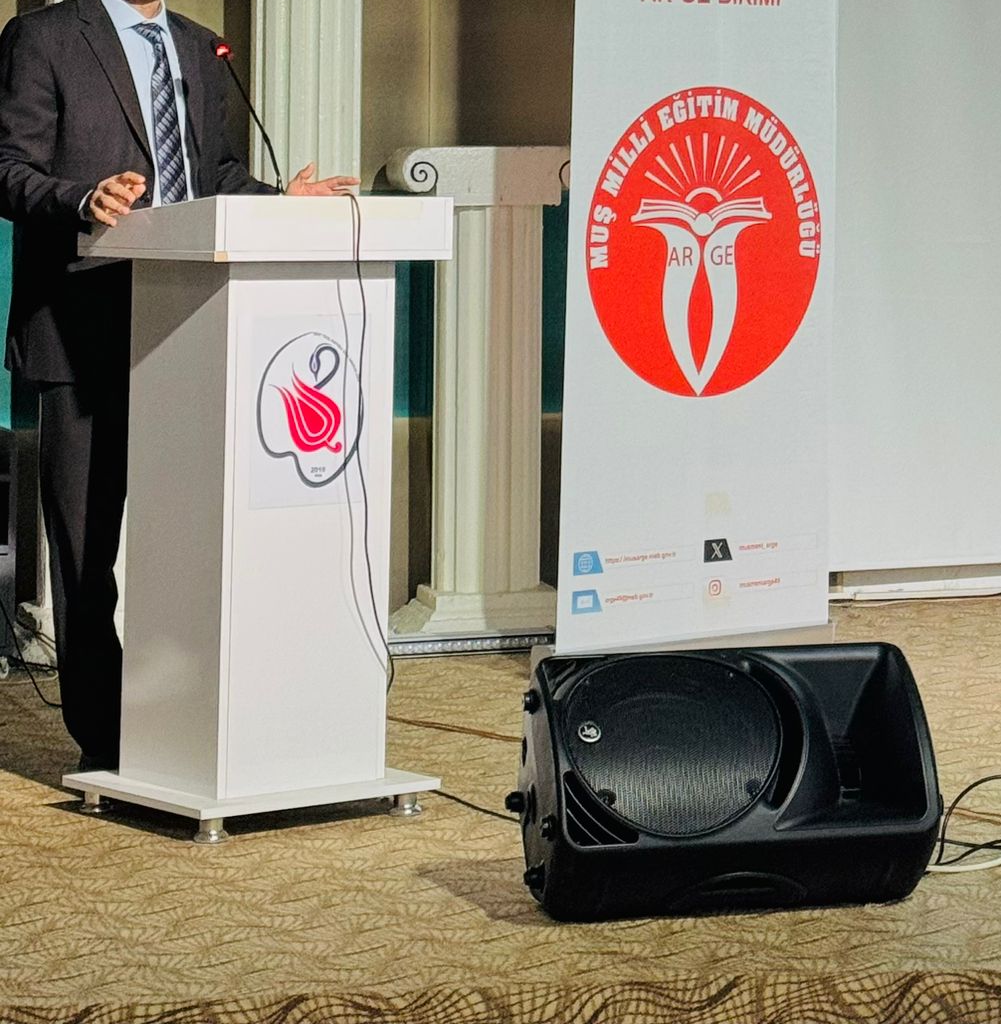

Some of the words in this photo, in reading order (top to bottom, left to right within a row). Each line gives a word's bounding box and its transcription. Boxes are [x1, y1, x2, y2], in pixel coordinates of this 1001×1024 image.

[657, 89, 740, 131] EĞİTİM
[601, 116, 656, 198] MİLLİ
[742, 106, 821, 258] MÜDÜRLÜĞÜ
[590, 204, 617, 270] MUŞ
[668, 246, 693, 267] AR
[710, 245, 733, 266] GE
